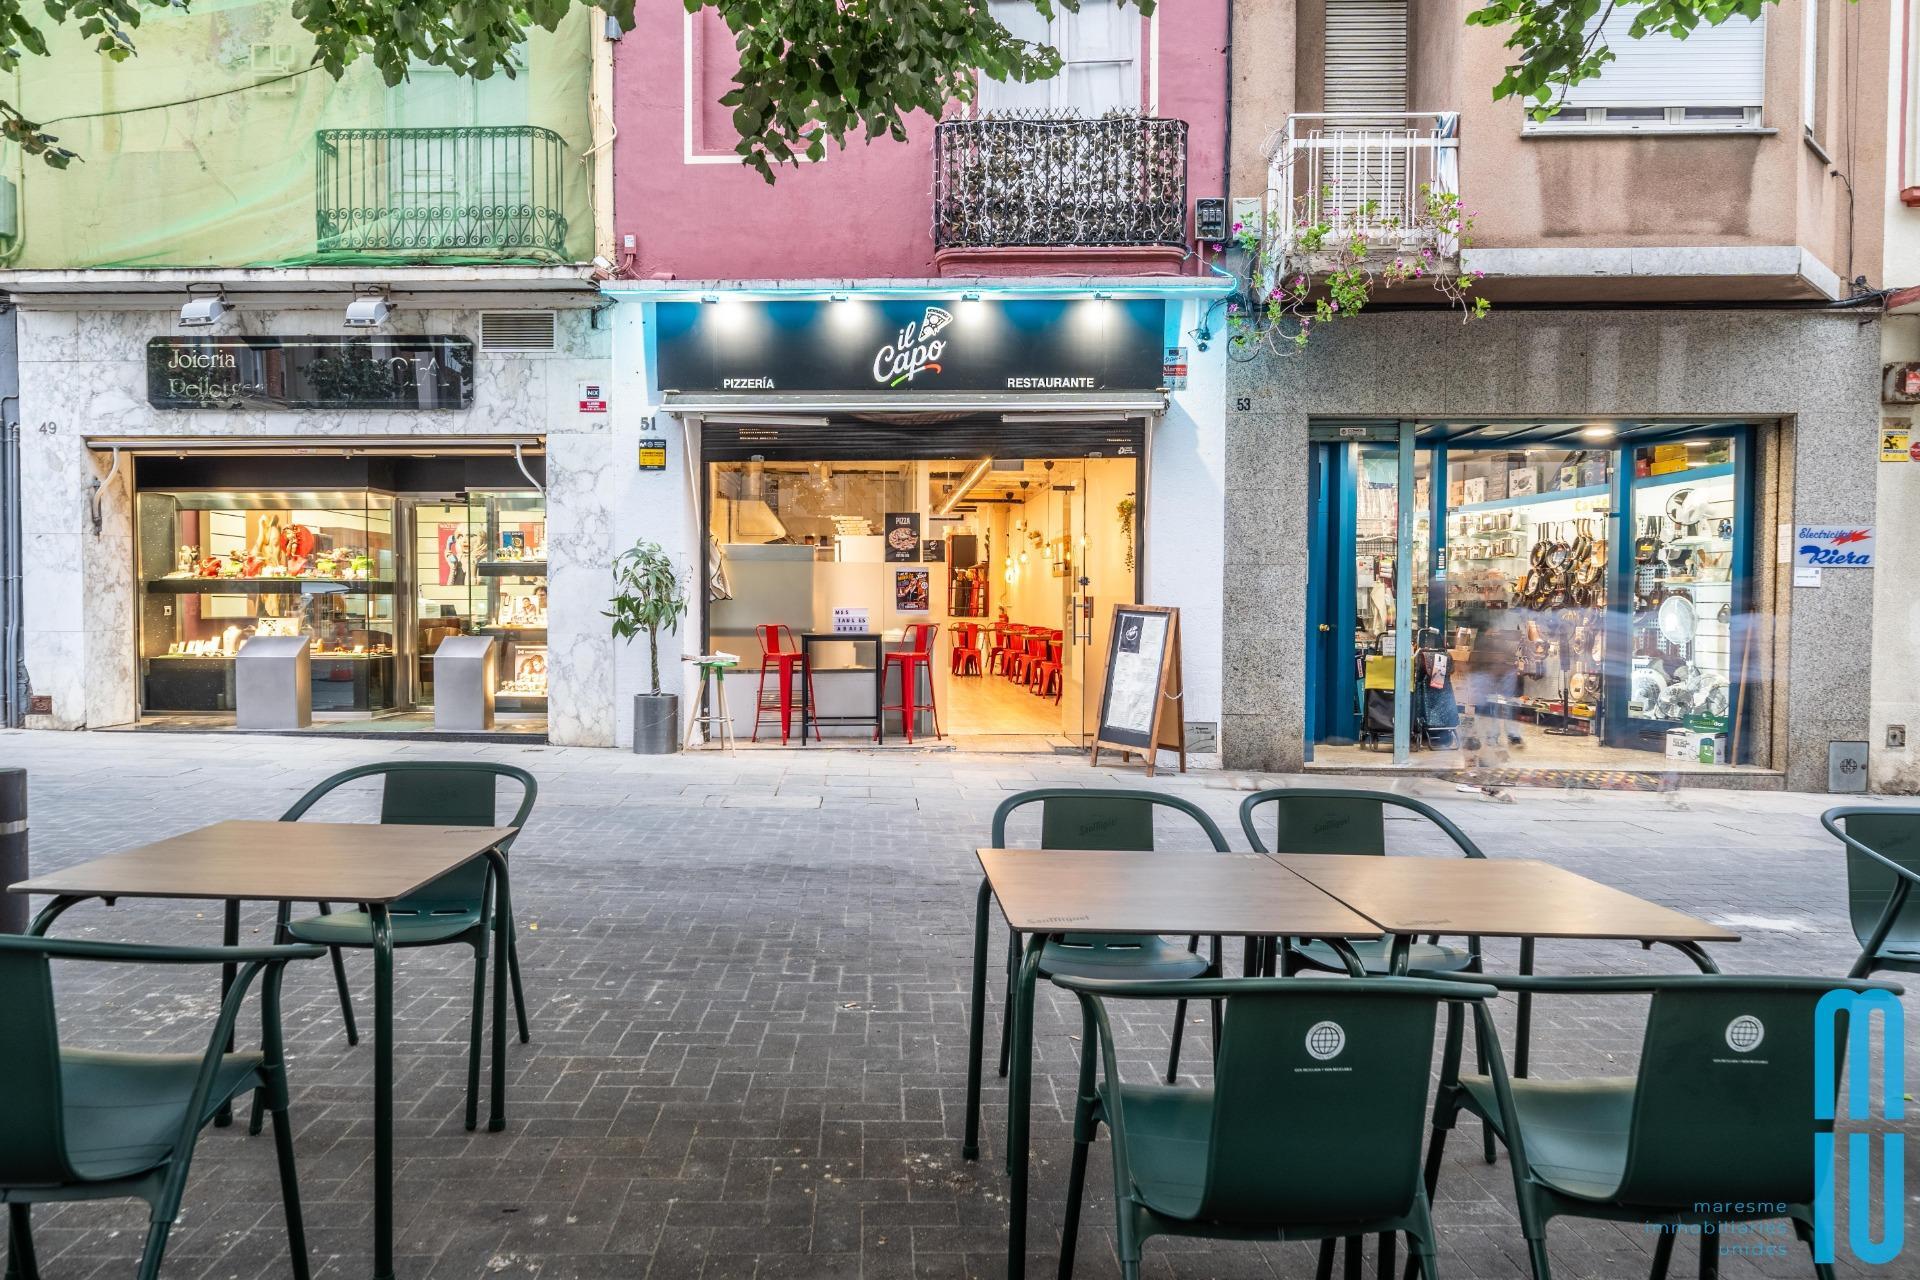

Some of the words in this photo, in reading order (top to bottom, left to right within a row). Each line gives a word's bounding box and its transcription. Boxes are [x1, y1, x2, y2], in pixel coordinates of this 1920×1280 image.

[897, 321, 915, 350] il
[873, 340, 946, 382] Capo
[723, 376, 775, 389] PIZZERÍA
[1007, 377, 1094, 388] RESTAURANTE
[1237, 398, 1250, 411] 53
[39, 421, 57, 435] 49
[640, 416, 657, 431] 51
[895, 517, 911, 525] PIZZA
[1799, 545, 1870, 565] Riera
